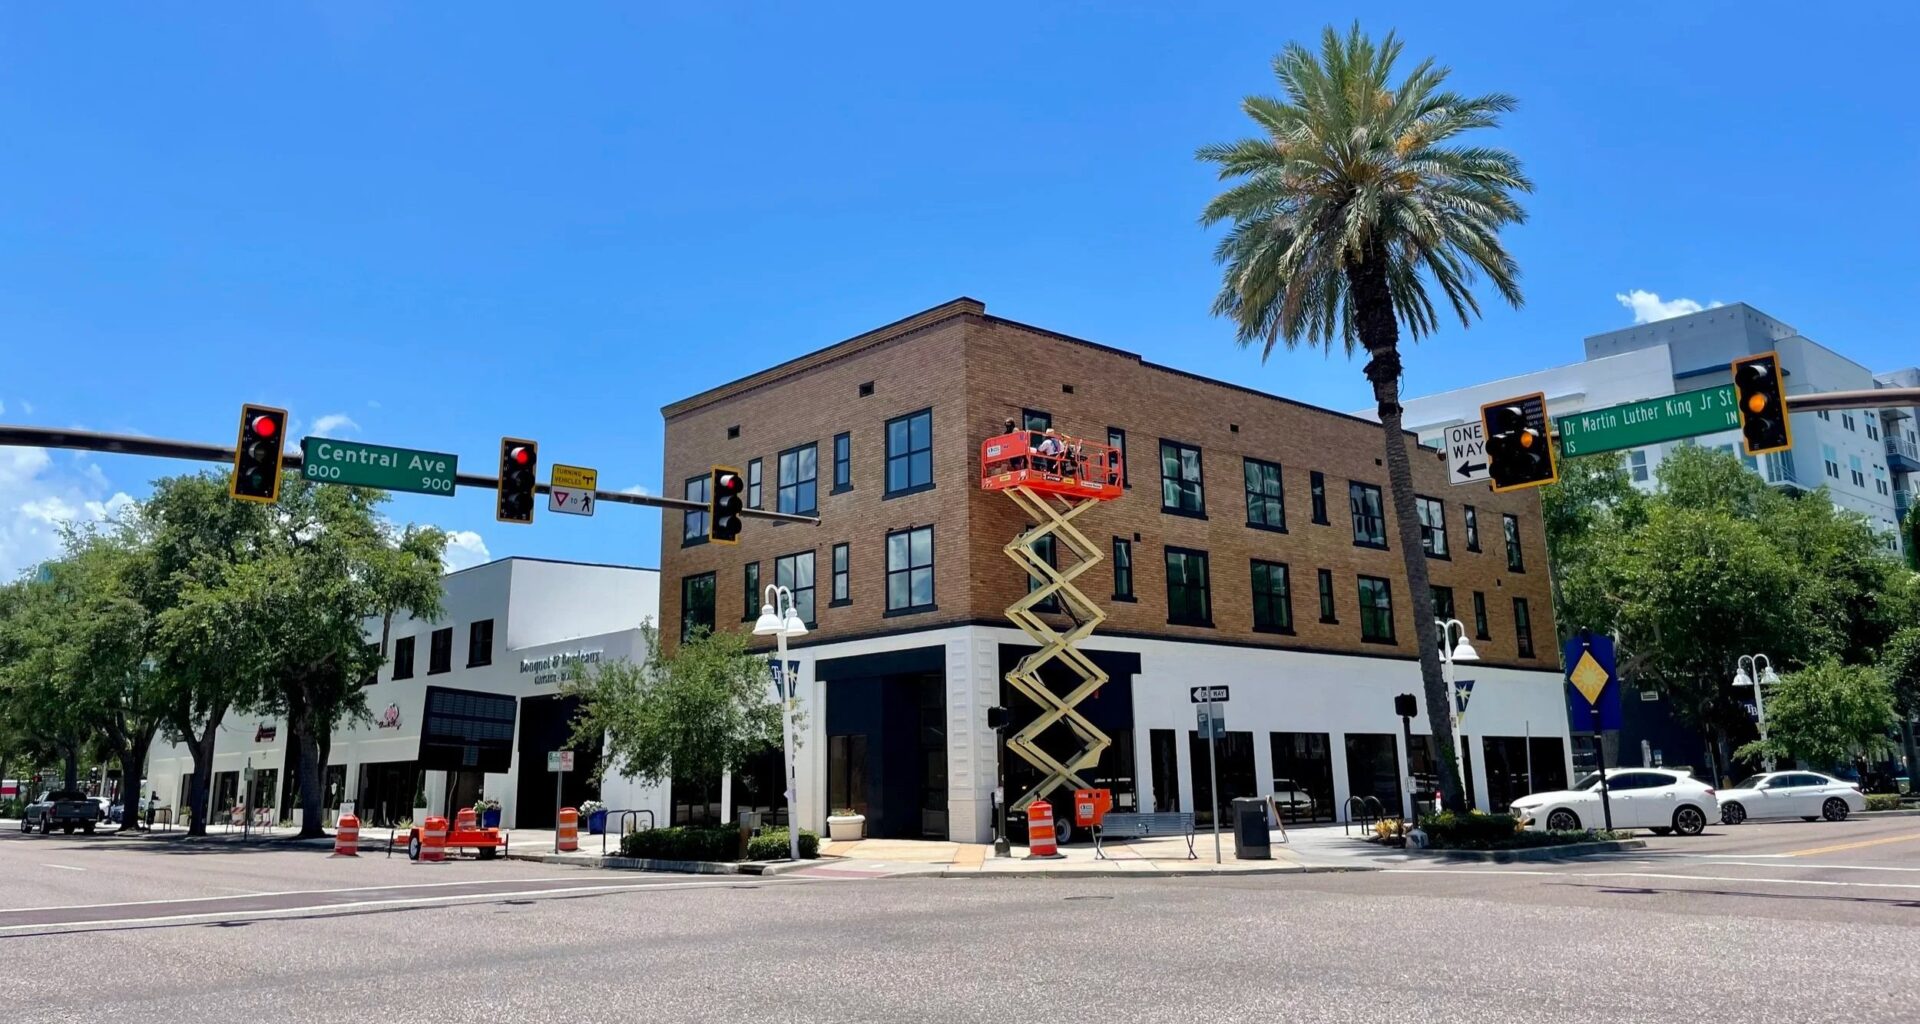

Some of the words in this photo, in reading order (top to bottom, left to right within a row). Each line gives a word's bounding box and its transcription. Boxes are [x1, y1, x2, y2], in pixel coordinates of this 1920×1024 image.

[1564, 420, 1576, 436] Dr
[1582, 413, 1616, 433] Martin
[1622, 406, 1659, 425] Luther
[1665, 400, 1692, 418] King
[1700, 393, 1711, 410] Jr
[1719, 389, 1732, 407] St
[1453, 425, 1482, 442] ONE
[1453, 440, 1484, 459] WAY
[318, 443, 398, 468] Central
[408, 455, 446, 473] Ave
[307, 464, 341, 479] 800
[556, 467, 582, 477] TURNING
[422, 477, 452, 491] 900
[554, 477, 582, 485] VEHICLES
[520, 656, 550, 673] Bouquet
[1744, 703, 1758, 716] TB
